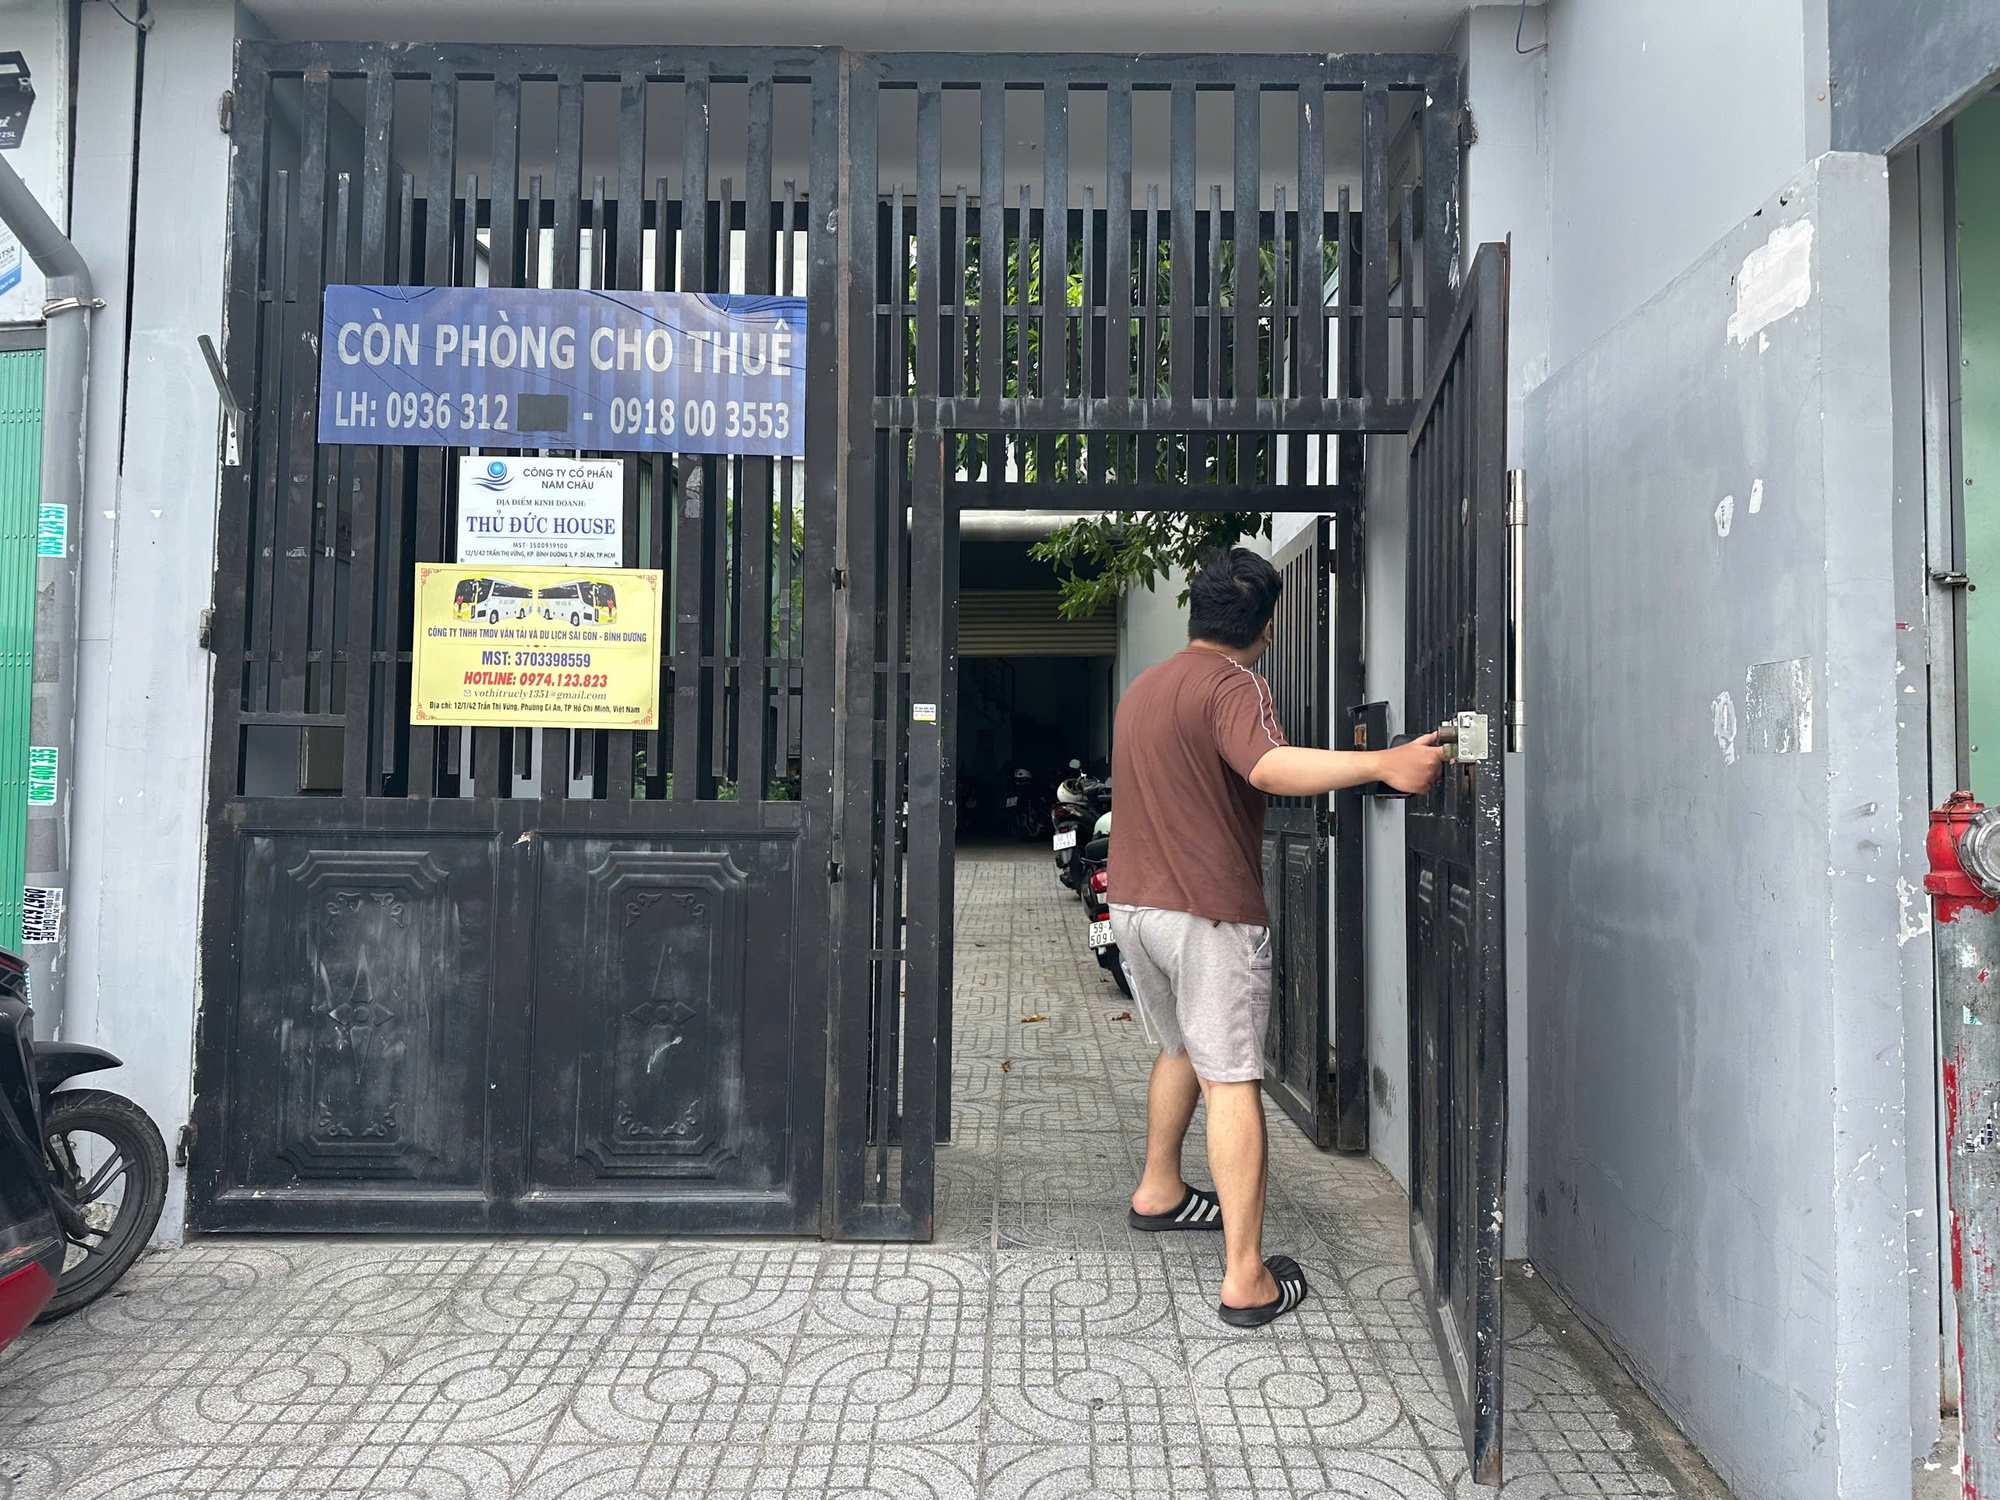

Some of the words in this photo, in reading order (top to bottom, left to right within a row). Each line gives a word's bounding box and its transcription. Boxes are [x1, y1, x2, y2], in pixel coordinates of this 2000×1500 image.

[338, 308, 420, 365] CÒN
[435, 310, 575, 369] PHÒNG
[590, 327, 673, 372] CHO
[686, 318, 792, 376] THUÊ
[335, 391, 377, 427] LH:
[386, 391, 451, 429] 0936
[460, 393, 508, 430] 312
[583, 412, 593, 421] -
[610, 397, 675, 436] 0918
[684, 399, 716, 437] 00
[725, 400, 789, 439] 3553
[523, 466, 554, 478] CÔNG
[556, 469, 566, 477] TY
[568, 465, 585, 478] CỔ
[586, 466, 613, 478] PHẦN
[541, 480, 565, 489] NAM
[566, 479, 594, 490] CHÂU
[556, 499, 586, 507] DOANH:
[466, 509, 505, 533] THỦ
[508, 512, 548, 534] ĐỨC
[553, 517, 616, 535] HOUSE
[428, 626, 447, 637] CÔNG
[449, 627, 457, 637] TY
[460, 628, 477, 638] TNHH
[480, 628, 498, 638] TMDV
[516, 626, 527, 639] TẢI
[529, 628, 538, 639] VÀ
[540, 630, 549, 639] DU
[551, 630, 567, 641] LỊCH
[569, 629, 580, 640] SÀI
[582, 629, 598, 641] GÒN
[604, 629, 621, 641] BÌNH
[481, 651, 511, 666] MST:
[515, 652, 591, 668] 3703398559
[463, 671, 517, 686] HOTLINE:
[519, 672, 608, 688] 0974.123.823
[474, 689, 607, 701] vothitrucly1351@gmail.com
[454, 702, 476, 710] 12/1/42
[564, 704, 572, 712] TP
[625, 705, 640, 713] Nam
[23, 888, 47, 908] 0967
[22, 909, 44, 924] 633
[21, 925, 42, 941] 455
